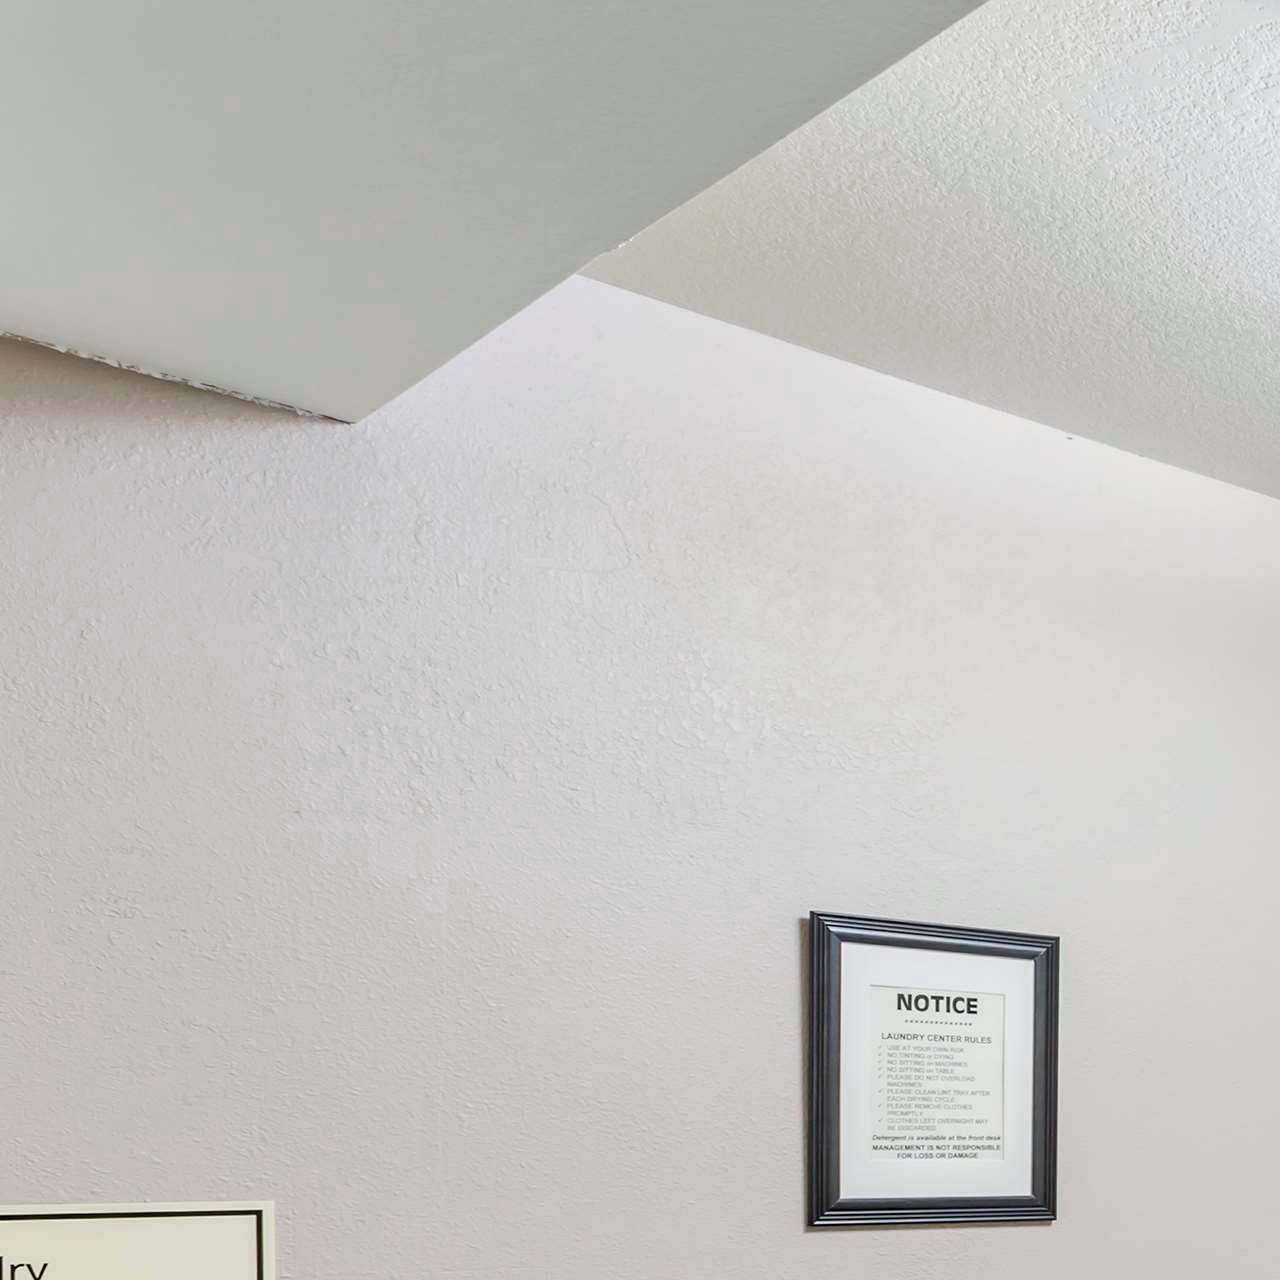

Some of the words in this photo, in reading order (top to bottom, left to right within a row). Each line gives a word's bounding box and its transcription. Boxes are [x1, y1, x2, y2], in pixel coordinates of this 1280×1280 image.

[897, 993, 978, 1015] NOTICE
[881, 1032, 925, 1041] LAUNDRY
[927, 1034, 962, 1043] CENTER
[964, 1036, 992, 1044] RULES
